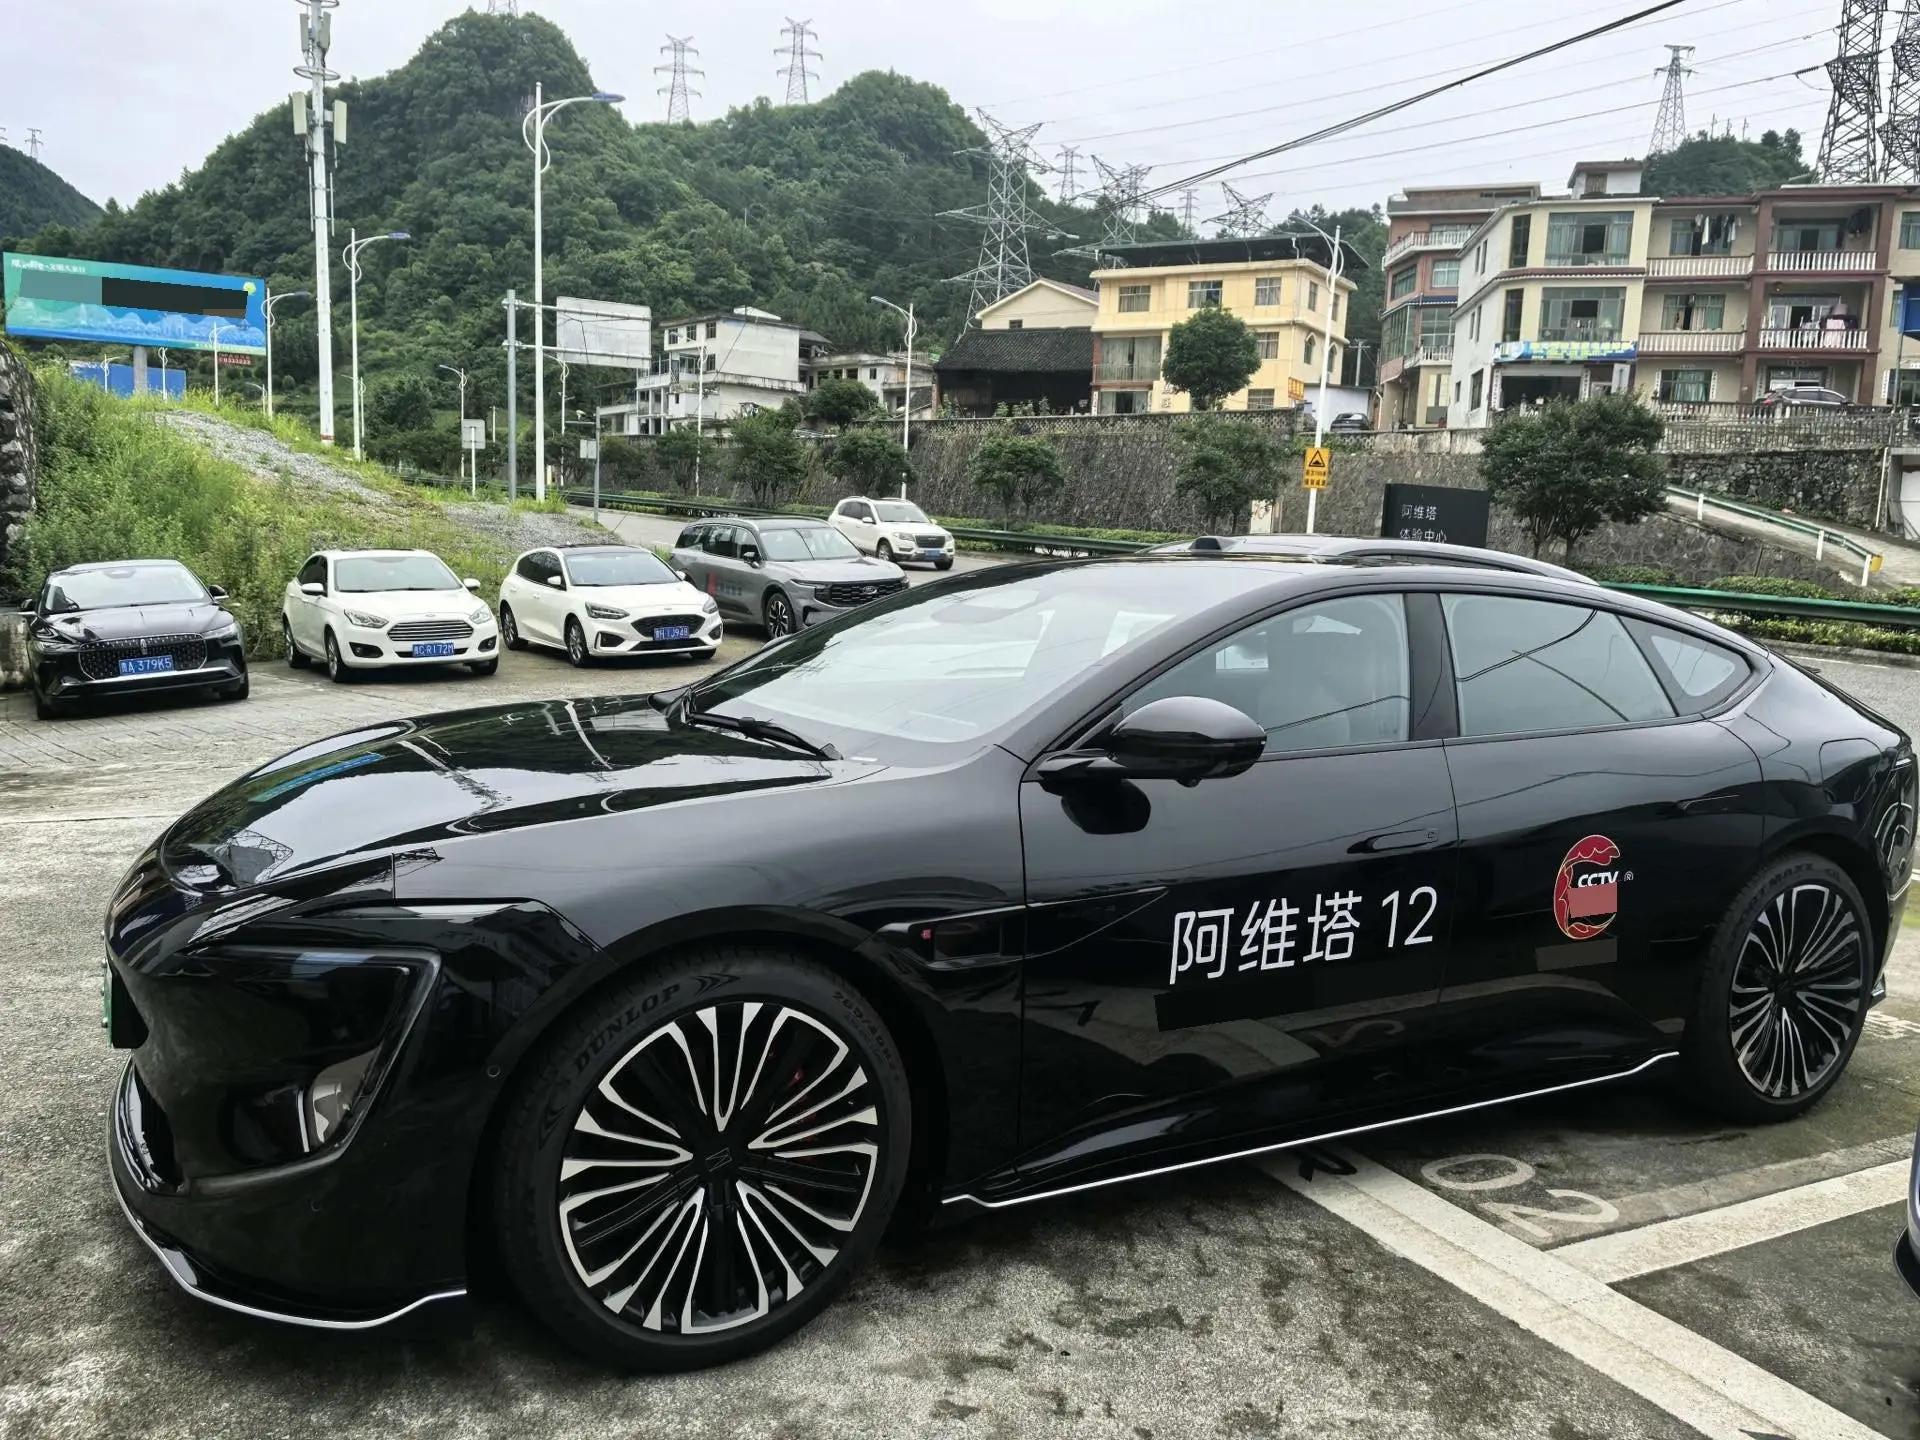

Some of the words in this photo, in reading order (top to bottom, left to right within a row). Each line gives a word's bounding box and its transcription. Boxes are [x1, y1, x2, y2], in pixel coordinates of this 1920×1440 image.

[1401, 504, 1437, 521] 阿维塔
[1400, 528, 1447, 544] 体验中心
[1577, 871, 1619, 888] CCTV
[1169, 889, 1362, 984] 阿维塔
[1381, 885, 1438, 948] 12
[574, 982, 682, 1074] DUNLOP
